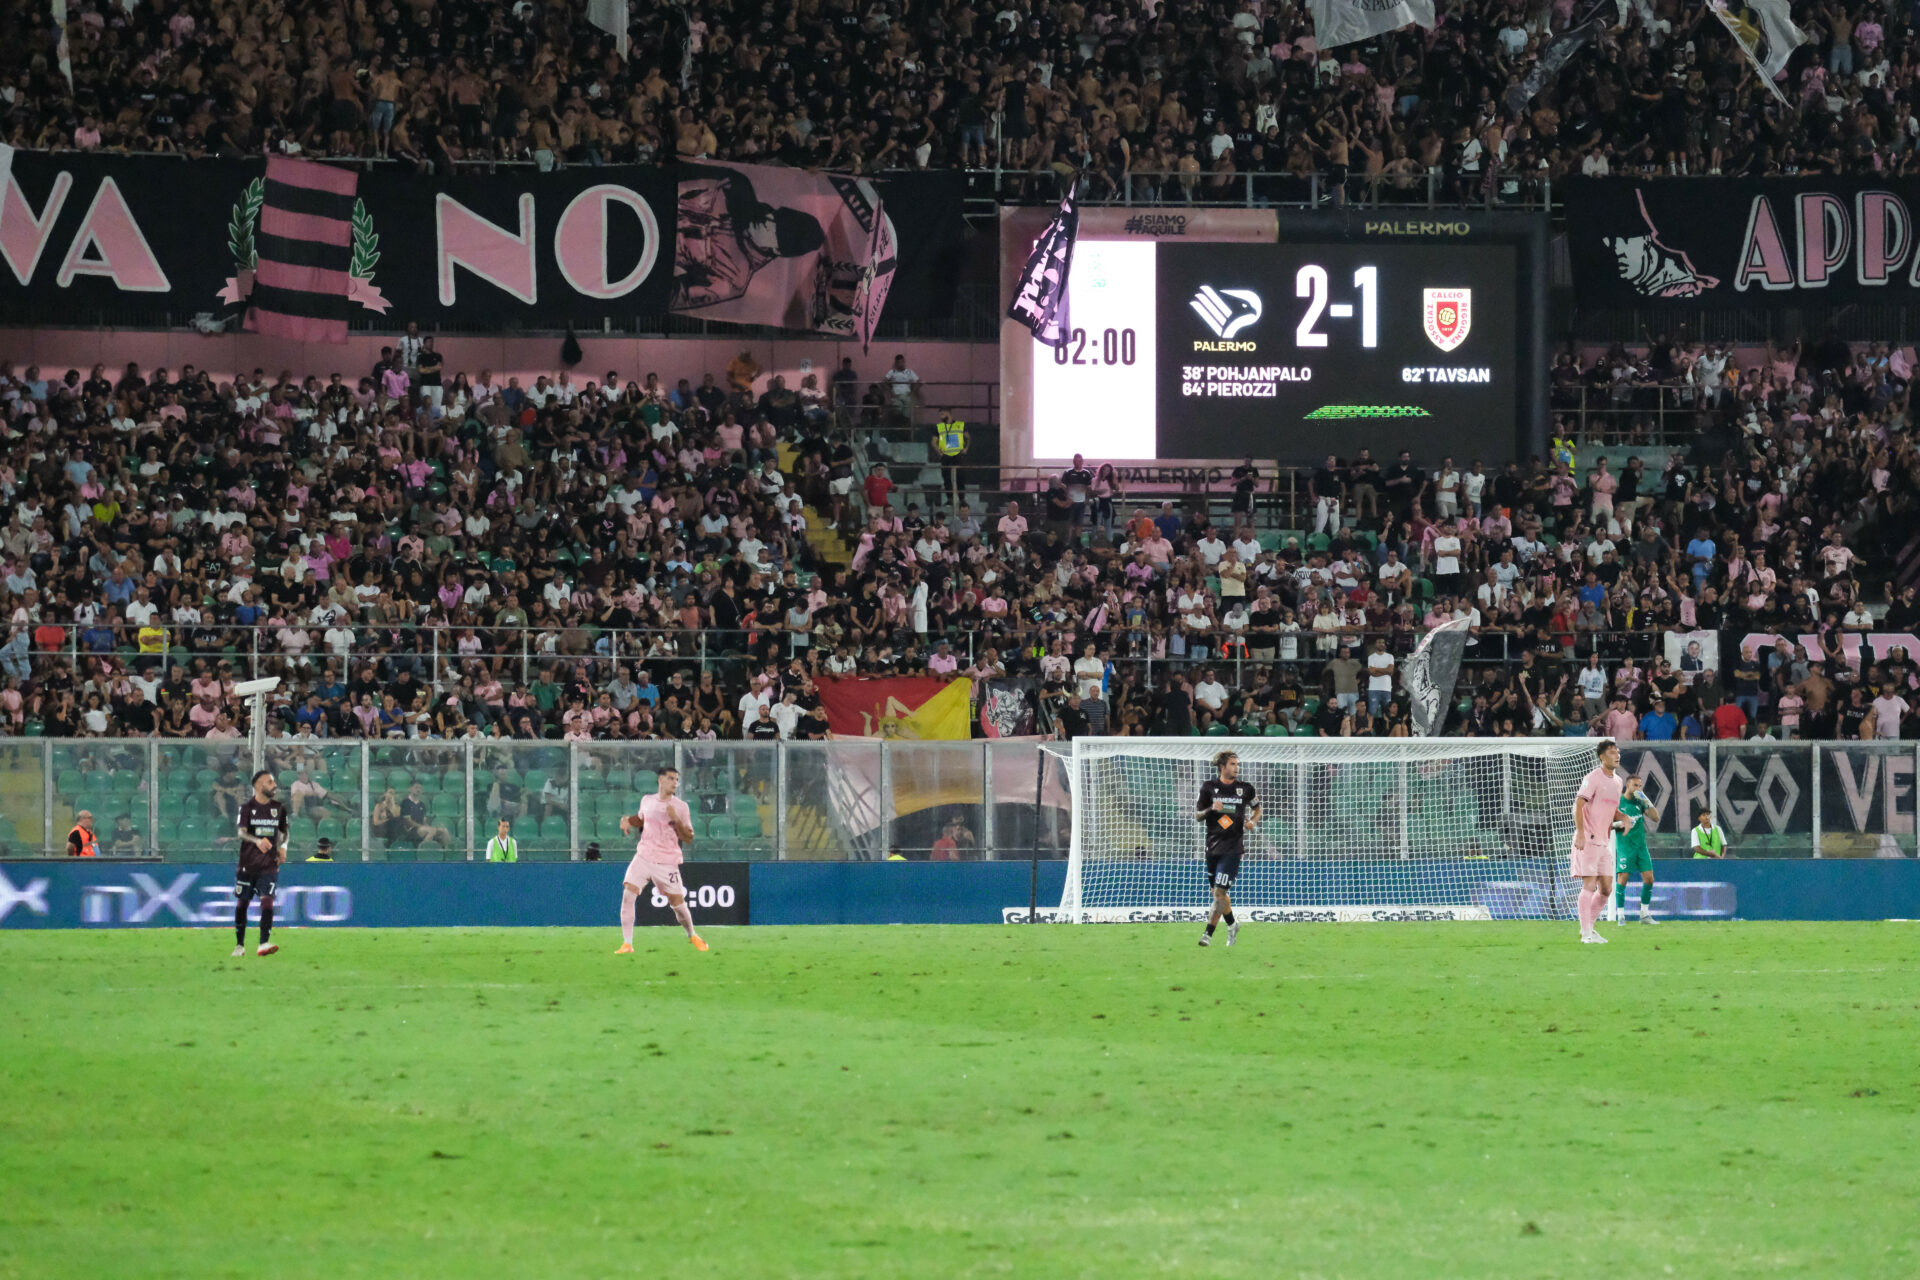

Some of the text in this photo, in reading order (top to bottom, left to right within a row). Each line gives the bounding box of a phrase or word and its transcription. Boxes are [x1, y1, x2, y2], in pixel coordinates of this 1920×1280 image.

[1141, 224, 1186, 236] AQUILE
[1365, 222, 1470, 236] PALERMO
[436, 184, 660, 306] NO
[1450, 302, 1468, 344] REGGIANA
[1193, 341, 1257, 351] PALERMO
[1182, 366, 1312, 381] 38' POHJANPALO
[1402, 368, 1491, 382] 62' TAVSAN
[1182, 382, 1277, 397] 64' PIEROZZI
[1618, 750, 1800, 834] ORGO
[1215, 872, 1229, 886] 90
[269, 882, 275, 895] 7
